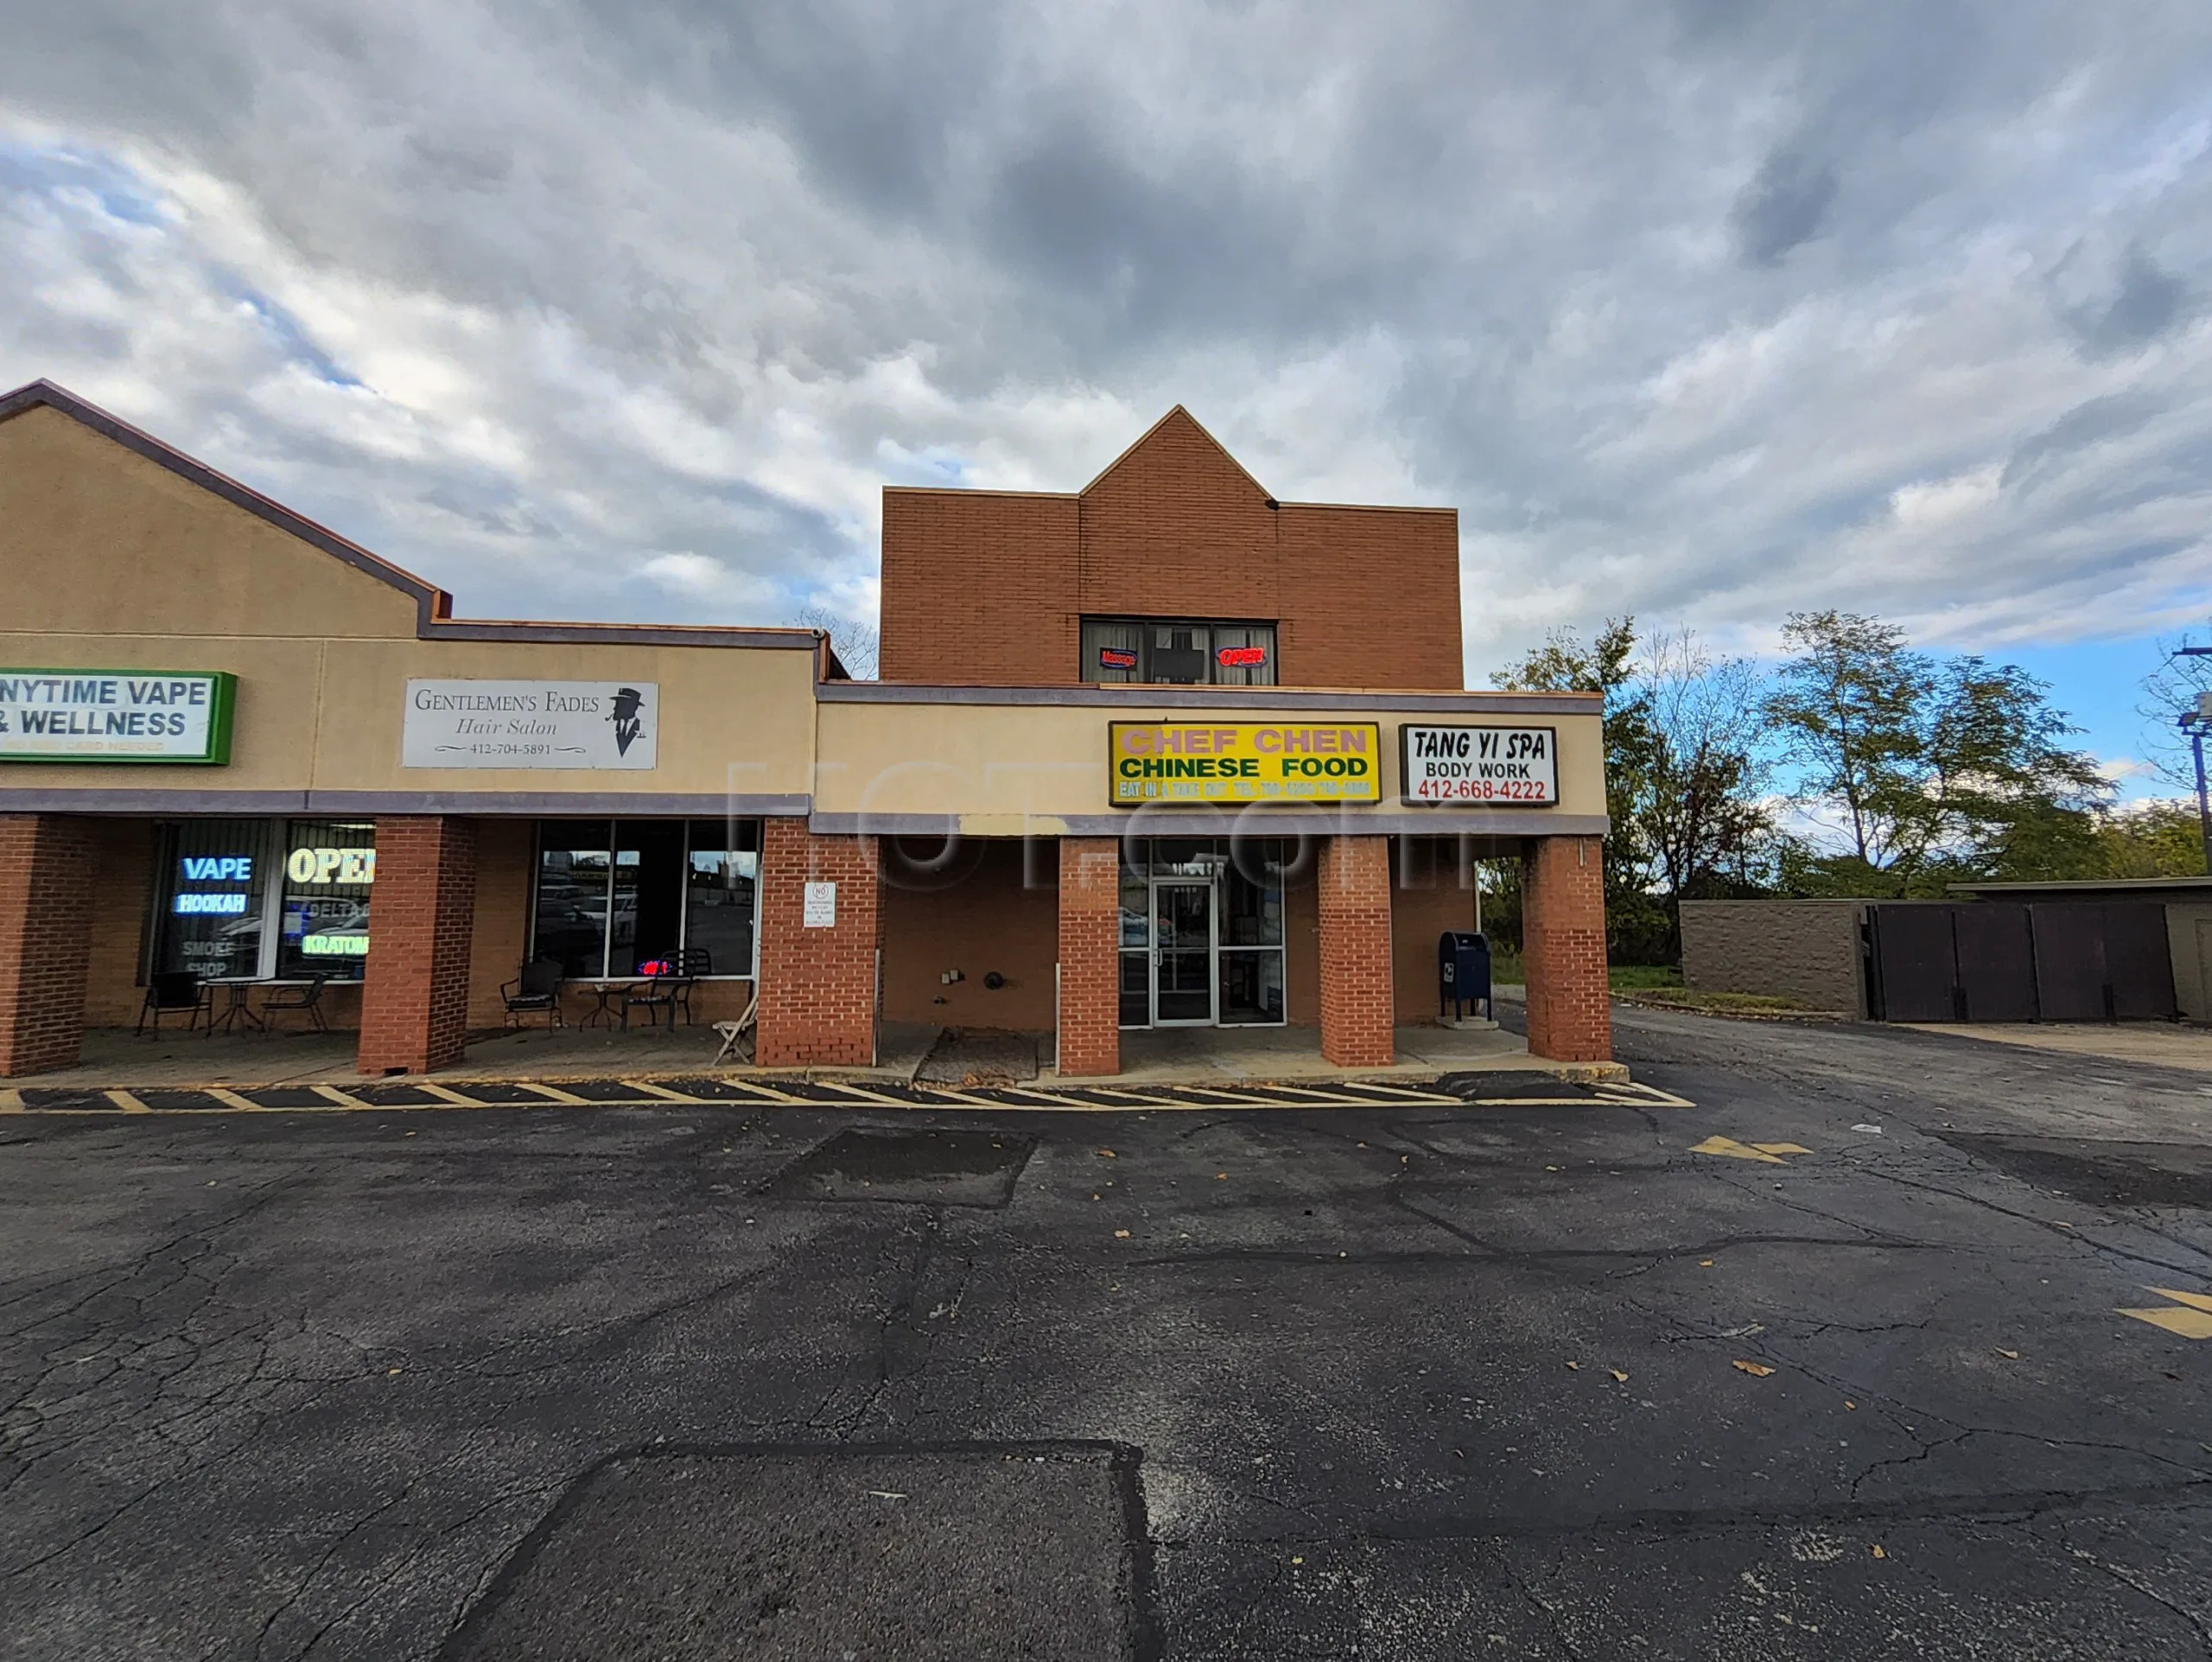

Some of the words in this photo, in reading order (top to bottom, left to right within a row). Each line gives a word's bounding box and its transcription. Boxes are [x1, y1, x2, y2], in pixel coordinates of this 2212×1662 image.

[1218, 647, 1266, 667] OPEN
[128, 681, 207, 704] VAPE
[415, 689, 537, 711] GENTLEMEN'S
[545, 691, 600, 712] FADES
[21, 710, 186, 735] WELLNESS
[455, 718, 502, 735] Hair
[506, 719, 557, 735] Salon
[470, 743, 550, 755] 412-704-5891
[1121, 729, 1237, 755] CHEF
[1254, 729, 1367, 755] CHEN
[1414, 731, 1471, 758] TANG
[1478, 732, 1500, 759] YI
[1506, 733, 1545, 760] SPA
[1119, 758, 1260, 778] CHINESE
[1281, 758, 1368, 777] FOOD
[1426, 762, 1473, 778] BODY
[1478, 763, 1530, 779] WORK
[1119, 781, 1141, 797] EAT
[1145, 781, 1156, 797] IN
[1418, 780, 1546, 799] 412-668-4222
[181, 857, 251, 880] VAPE
[177, 894, 247, 913] HOOKAH
[304, 935, 371, 954] KRATOM
